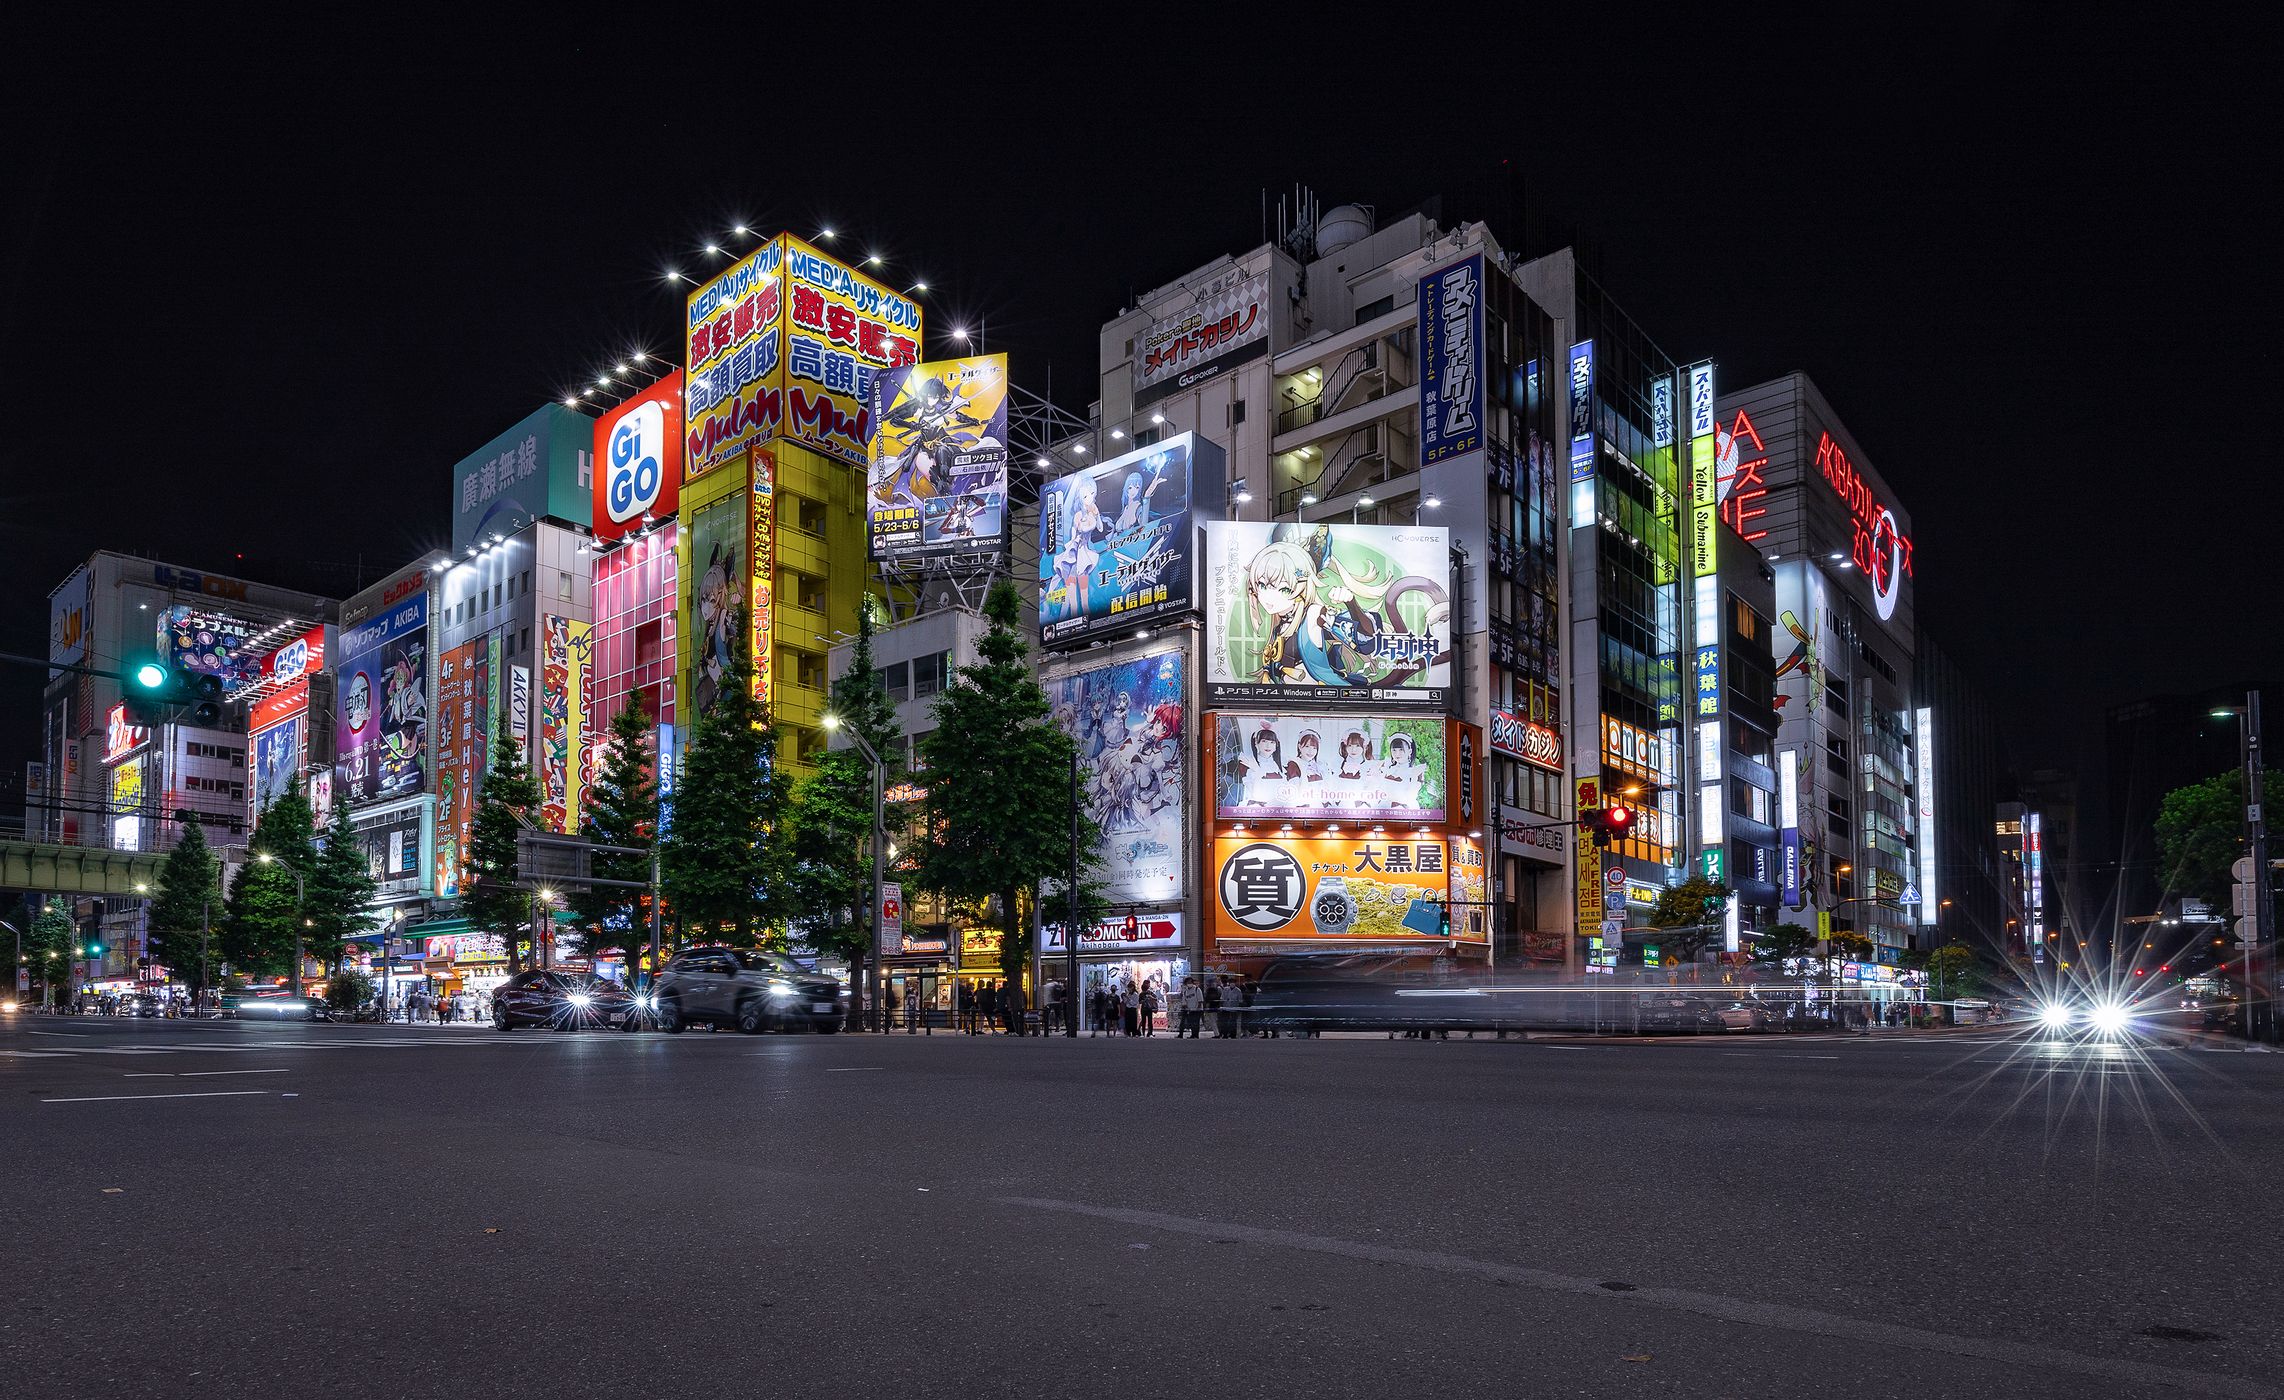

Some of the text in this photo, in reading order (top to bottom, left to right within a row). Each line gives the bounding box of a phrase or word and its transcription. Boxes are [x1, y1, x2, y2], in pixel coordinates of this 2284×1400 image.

[689, 240, 782, 330] MEDIAリサイクル
[689, 278, 782, 373] 激安販売
[1144, 302, 1258, 378] メイドカジノ
[688, 326, 781, 422] 高額買取
[1694, 371, 1710, 431] スーパービル
[686, 387, 783, 475] Mulan
[1426, 390, 1437, 444] 秋葉原店
[971, 454, 1000, 463] ツクヨミ
[755, 494, 771, 506] DVD
[756, 524, 769, 534] CD
[1695, 465, 1709, 570] Yellow Submarine
[1110, 583, 1168, 615] 配信開始
[394, 605, 419, 630] AKIBA
[354, 619, 389, 649] ソフマップ
[1372, 623, 1440, 674] 原神
[1379, 661, 1420, 670] Genshin
[1501, 642, 1513, 664] 5F
[441, 660, 454, 680] 4F
[1698, 651, 1718, 715] 秋葉館
[512, 668, 526, 718] AKKY
[1283, 688, 1312, 697] Windows
[440, 728, 452, 749] 3F
[462, 678, 473, 809] 秋葉原 Hey
[1491, 713, 1562, 765] メイドカジノ
[345, 762, 372, 784] 6.21
[1360, 790, 1388, 800] cafe
[438, 803, 451, 823] 2F
[1311, 862, 1350, 874] チケット
[1354, 844, 1444, 873] 大黒屋
[1786, 845, 1794, 889] GALLERIA
[1230, 857, 1300, 920] 質
[1590, 870, 1601, 908] FREE
[1611, 872, 1622, 881] 40
[1081, 941, 1120, 950] Akihabara
